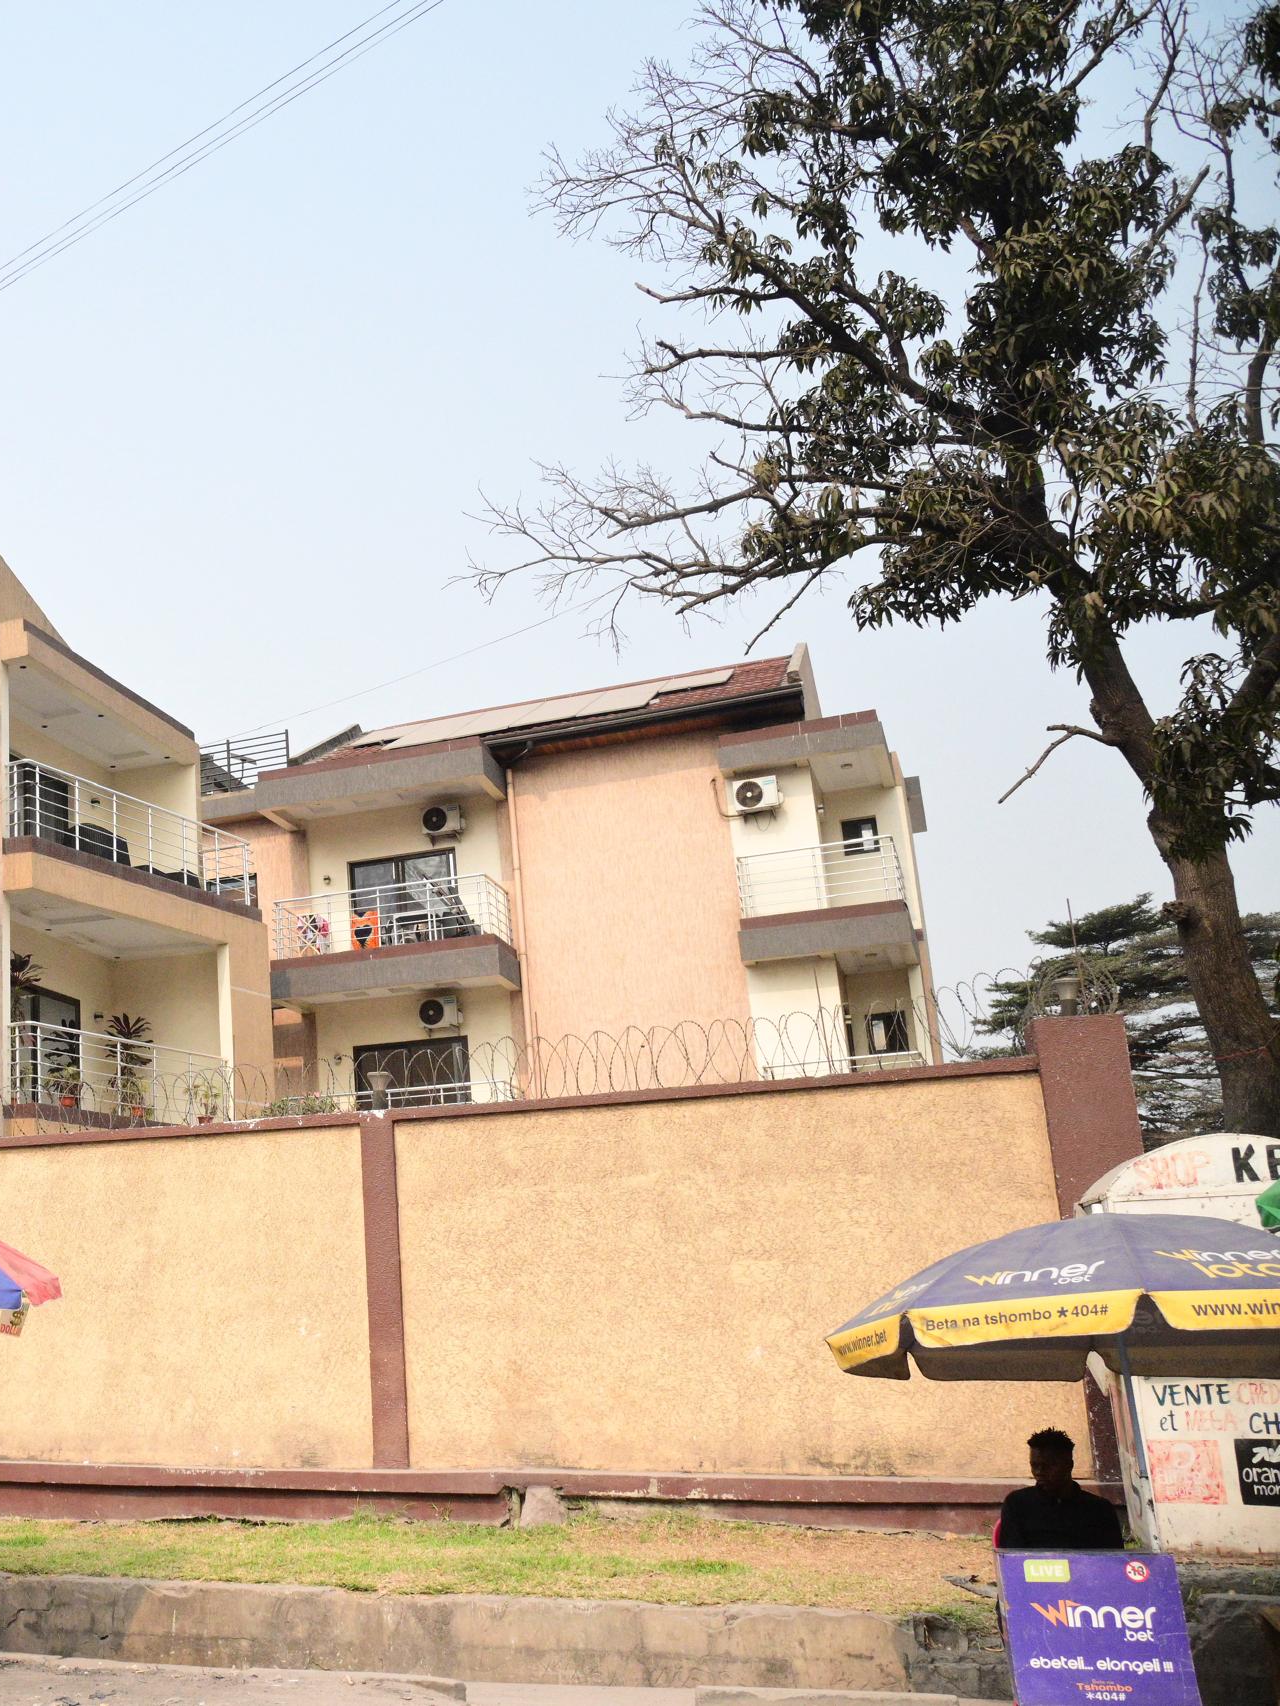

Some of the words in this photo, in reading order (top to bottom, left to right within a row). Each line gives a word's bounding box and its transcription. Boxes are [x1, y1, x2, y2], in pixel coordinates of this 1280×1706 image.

[925, 1319, 957, 1331] Beta
[962, 1316, 980, 1327] na
[985, 1308, 1052, 1326] tshombo
[1152, 1383, 1231, 1406] VENTE
[1160, 1410, 1178, 1431] et
[1030, 1564, 1064, 1577] LIVE
[1124, 1629, 1154, 1642] .bet
[1076, 1682, 1133, 1692] Tshombo
